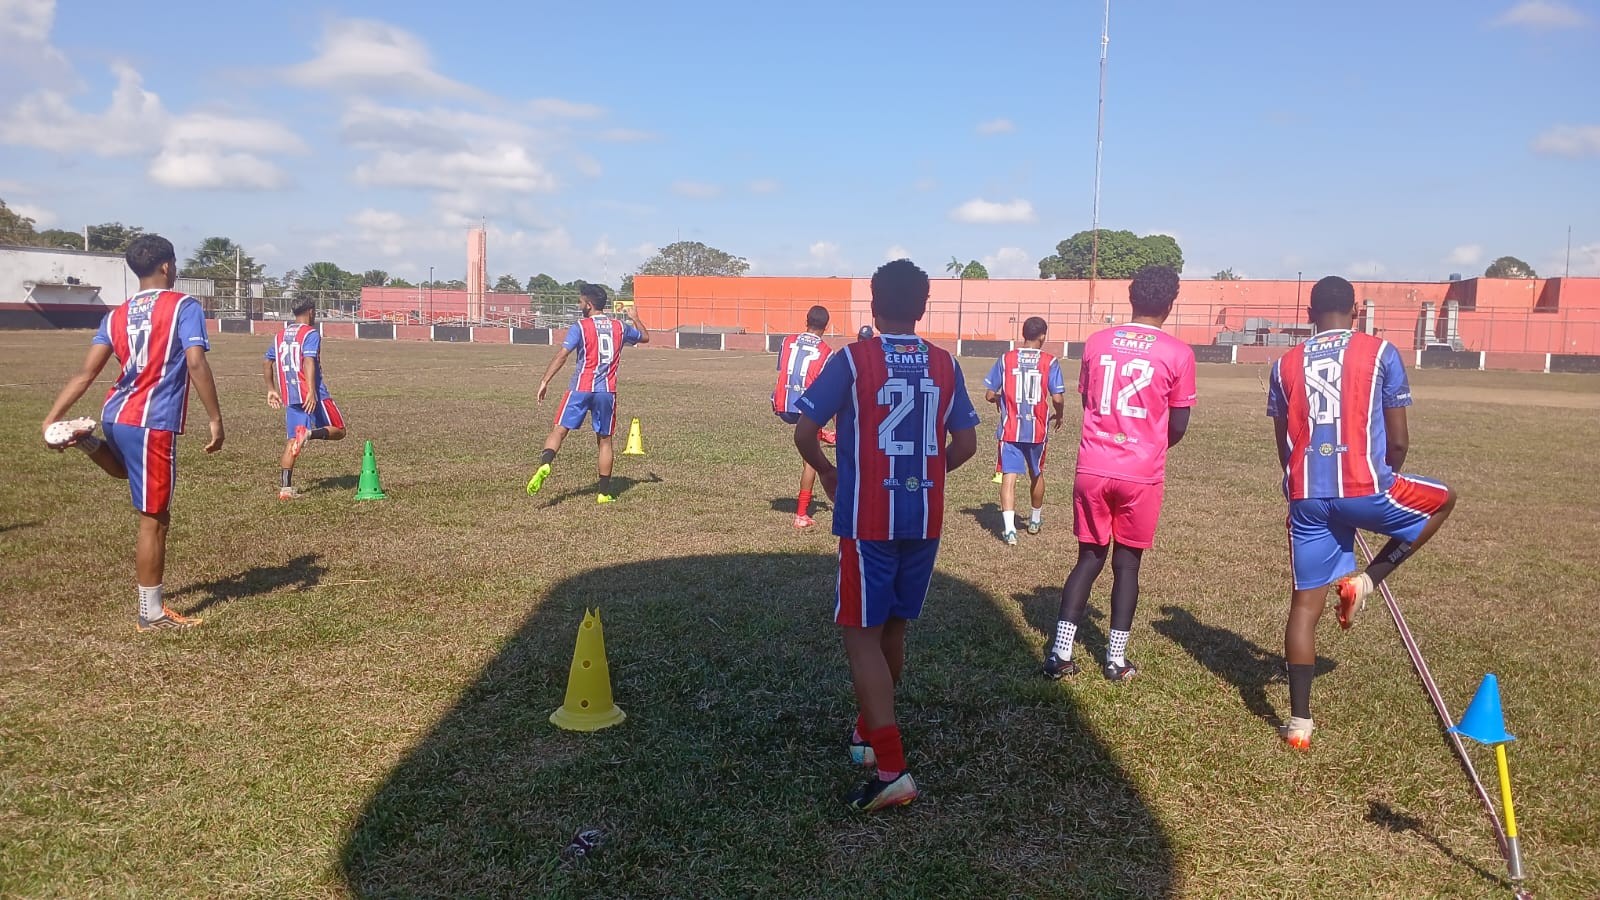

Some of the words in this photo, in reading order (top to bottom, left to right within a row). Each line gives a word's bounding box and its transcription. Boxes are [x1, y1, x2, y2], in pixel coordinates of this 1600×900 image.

[279, 341, 300, 371] 20
[599, 333, 614, 364] 9
[787, 342, 821, 377] 17
[885, 353, 929, 364] CEMEF
[1112, 338, 1153, 350] CEMEF
[1012, 367, 1042, 405] 10
[1100, 354, 1155, 419] 12
[877, 378, 940, 456] 21
[883, 478, 901, 487] SEEL
